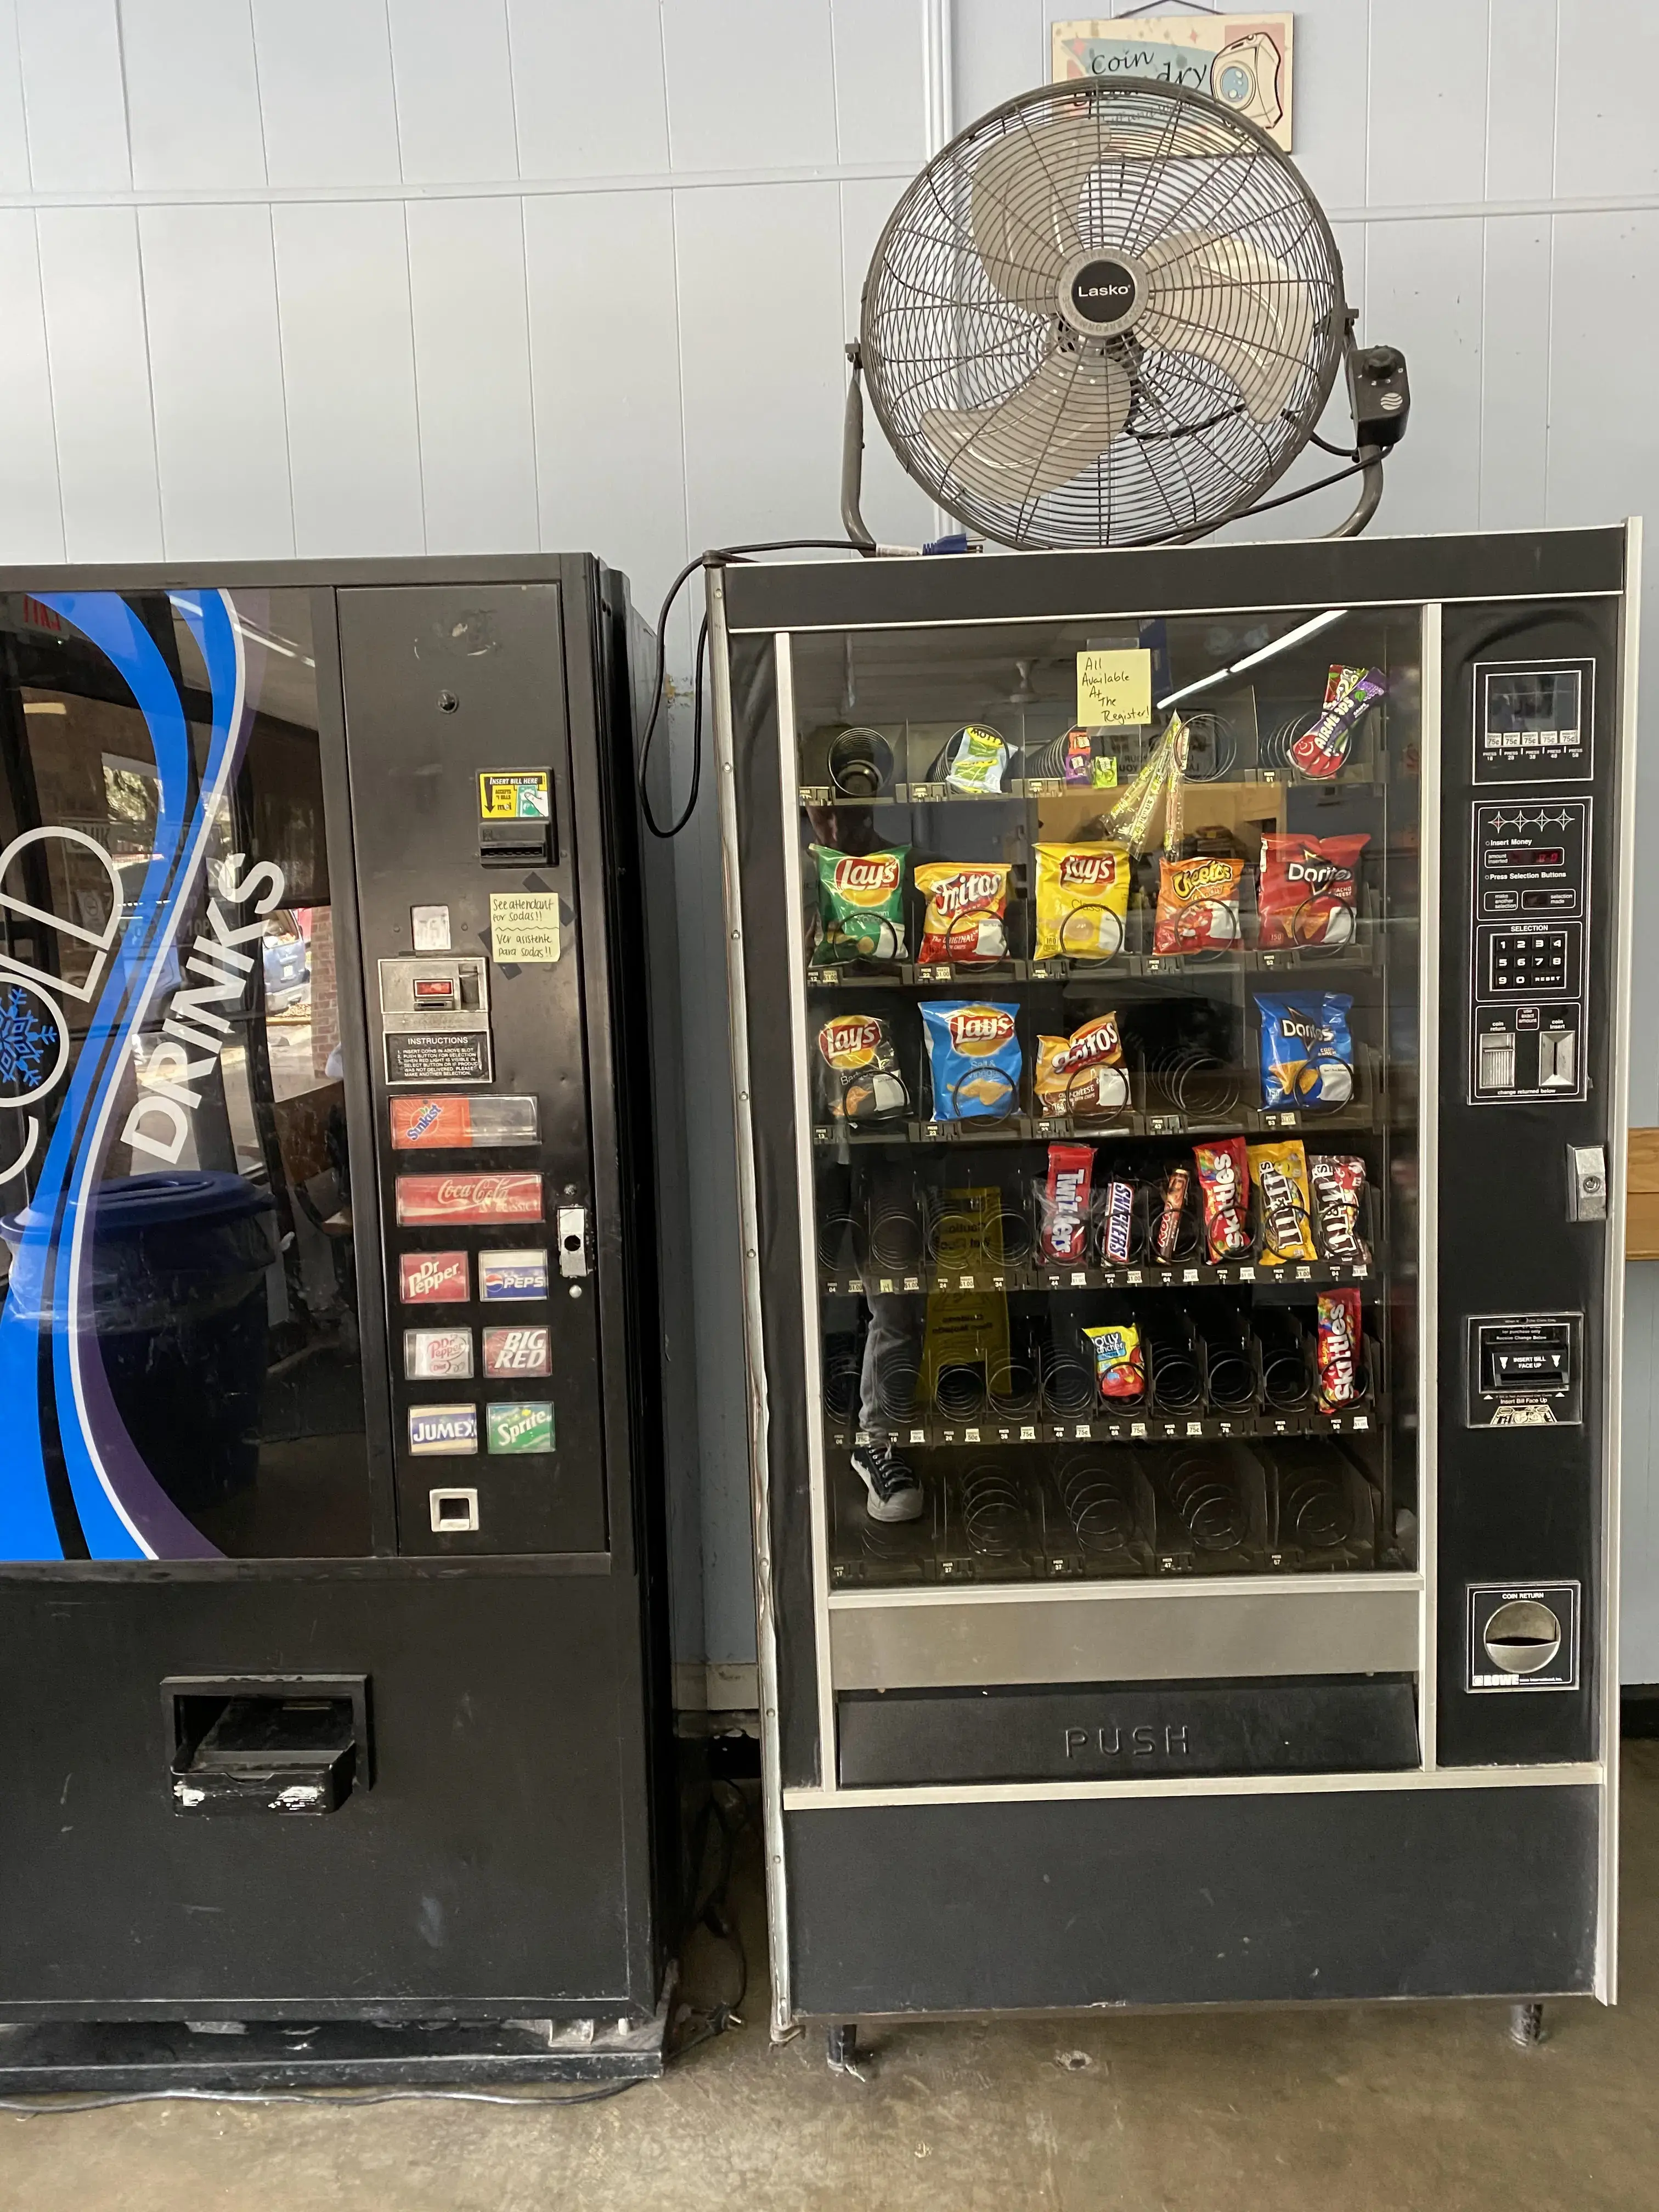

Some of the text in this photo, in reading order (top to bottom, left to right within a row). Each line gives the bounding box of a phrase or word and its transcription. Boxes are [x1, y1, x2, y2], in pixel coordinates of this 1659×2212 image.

[1092, 50, 1154, 75] Coin
[1078, 285, 1129, 297] Lasko
[1086, 657, 1102, 670] All
[1082, 670, 1130, 686] Available
[1090, 686, 1102, 698] At
[1098, 696, 1116, 707] The
[1101, 706, 1149, 725] Register!
[842, 859, 898, 890] Lay's
[1064, 855, 1114, 884] Lay's
[1173, 860, 1230, 897] Cheetos
[494, 898, 554, 911] See attendant
[932, 872, 1001, 915] Fritos
[496, 934, 552, 944] Ver asistente
[1517, 940, 1525, 949] 2
[499, 948, 516, 956] para
[121, 853, 285, 1163] DRINKS
[827, 1023, 877, 1059] Lay's
[952, 1015, 1010, 1045] Lay's
[407, 1103, 443, 1141] Sunkist
[438, 1178, 509, 1204] Coca-Cola
[1109, 1183, 1131, 1260] SNICKERS
[408, 1263, 459, 1297] Pepper
[420, 1261, 439, 1278] Dr
[504, 1330, 546, 1352] BIG
[494, 1350, 546, 1369] RED
[413, 1420, 475, 1442] JUMEX
[498, 1410, 546, 1446] Sprite
[1065, 1725, 1188, 1757] PUSH
